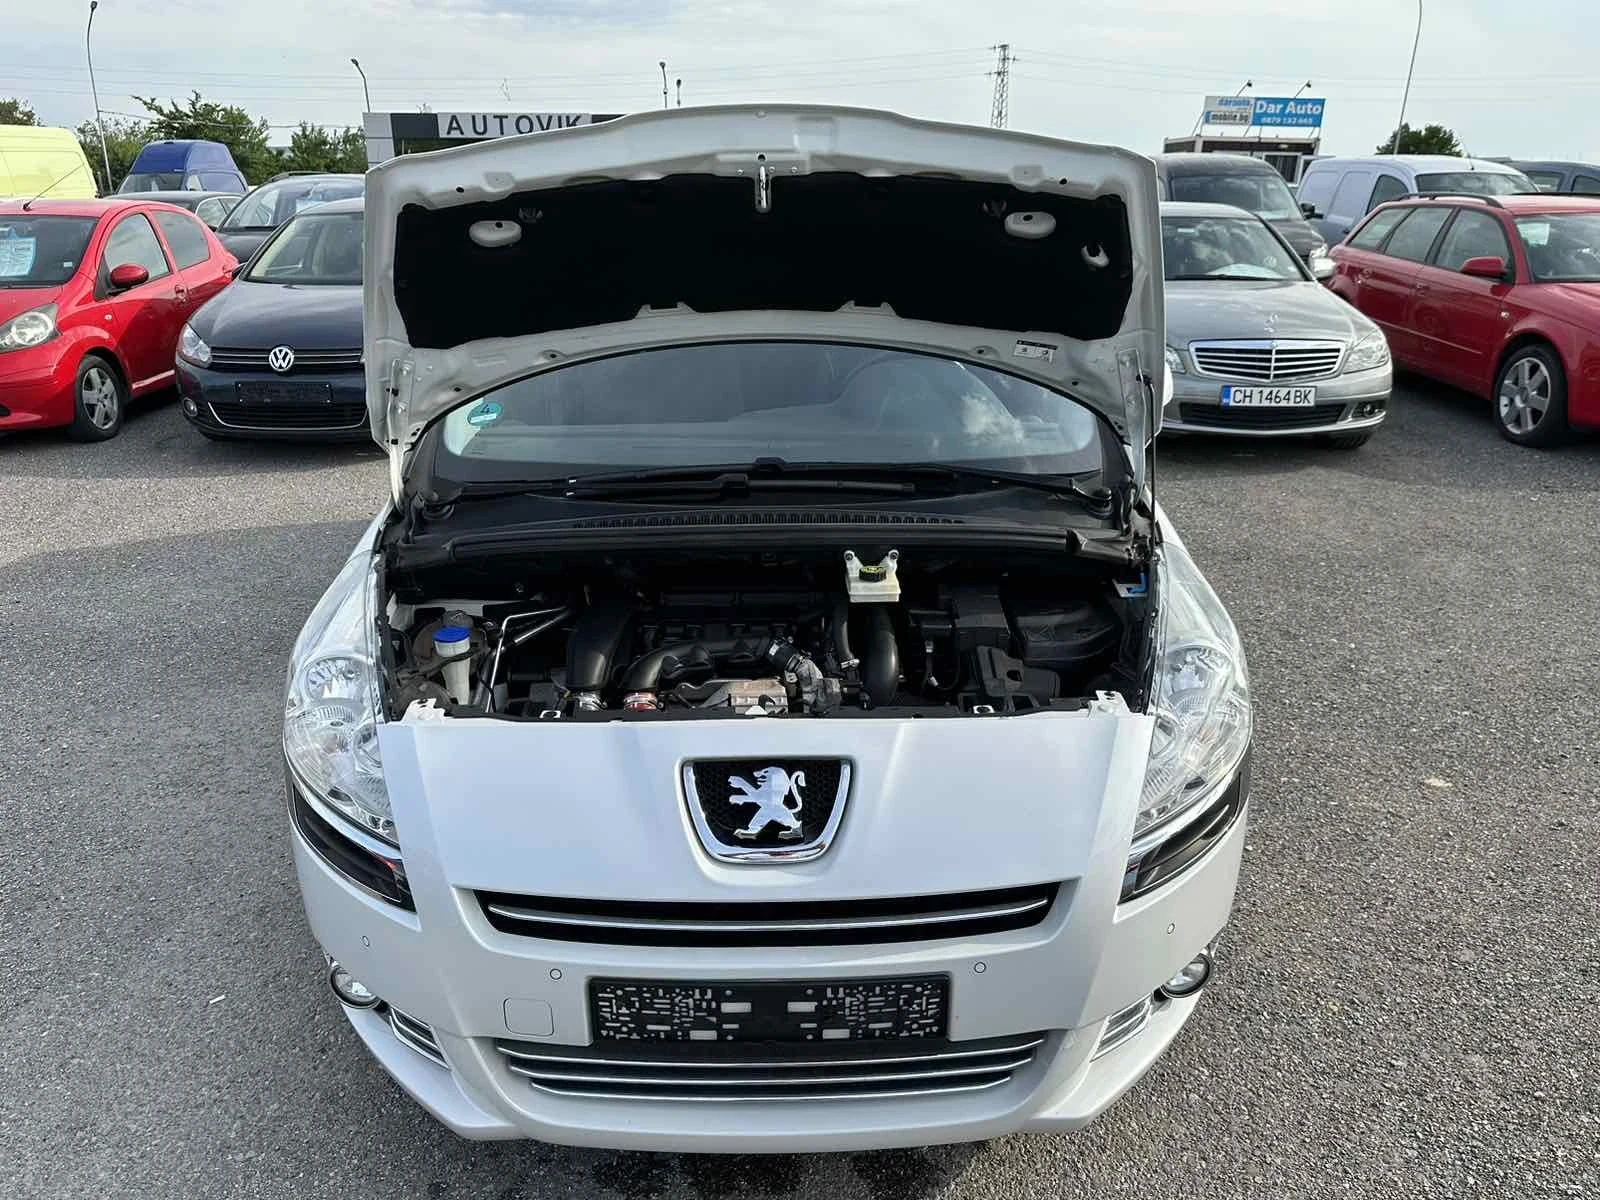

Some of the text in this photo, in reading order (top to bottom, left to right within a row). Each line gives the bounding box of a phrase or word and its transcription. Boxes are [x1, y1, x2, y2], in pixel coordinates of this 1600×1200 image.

[1256, 100, 1322, 115] Dar Auto
[446, 115, 582, 136] AUTOVIK
[269, 346, 294, 371] VW
[1233, 389, 1253, 404] CH
[1258, 390, 1292, 404] 1464
[1294, 390, 1312, 404] BK
